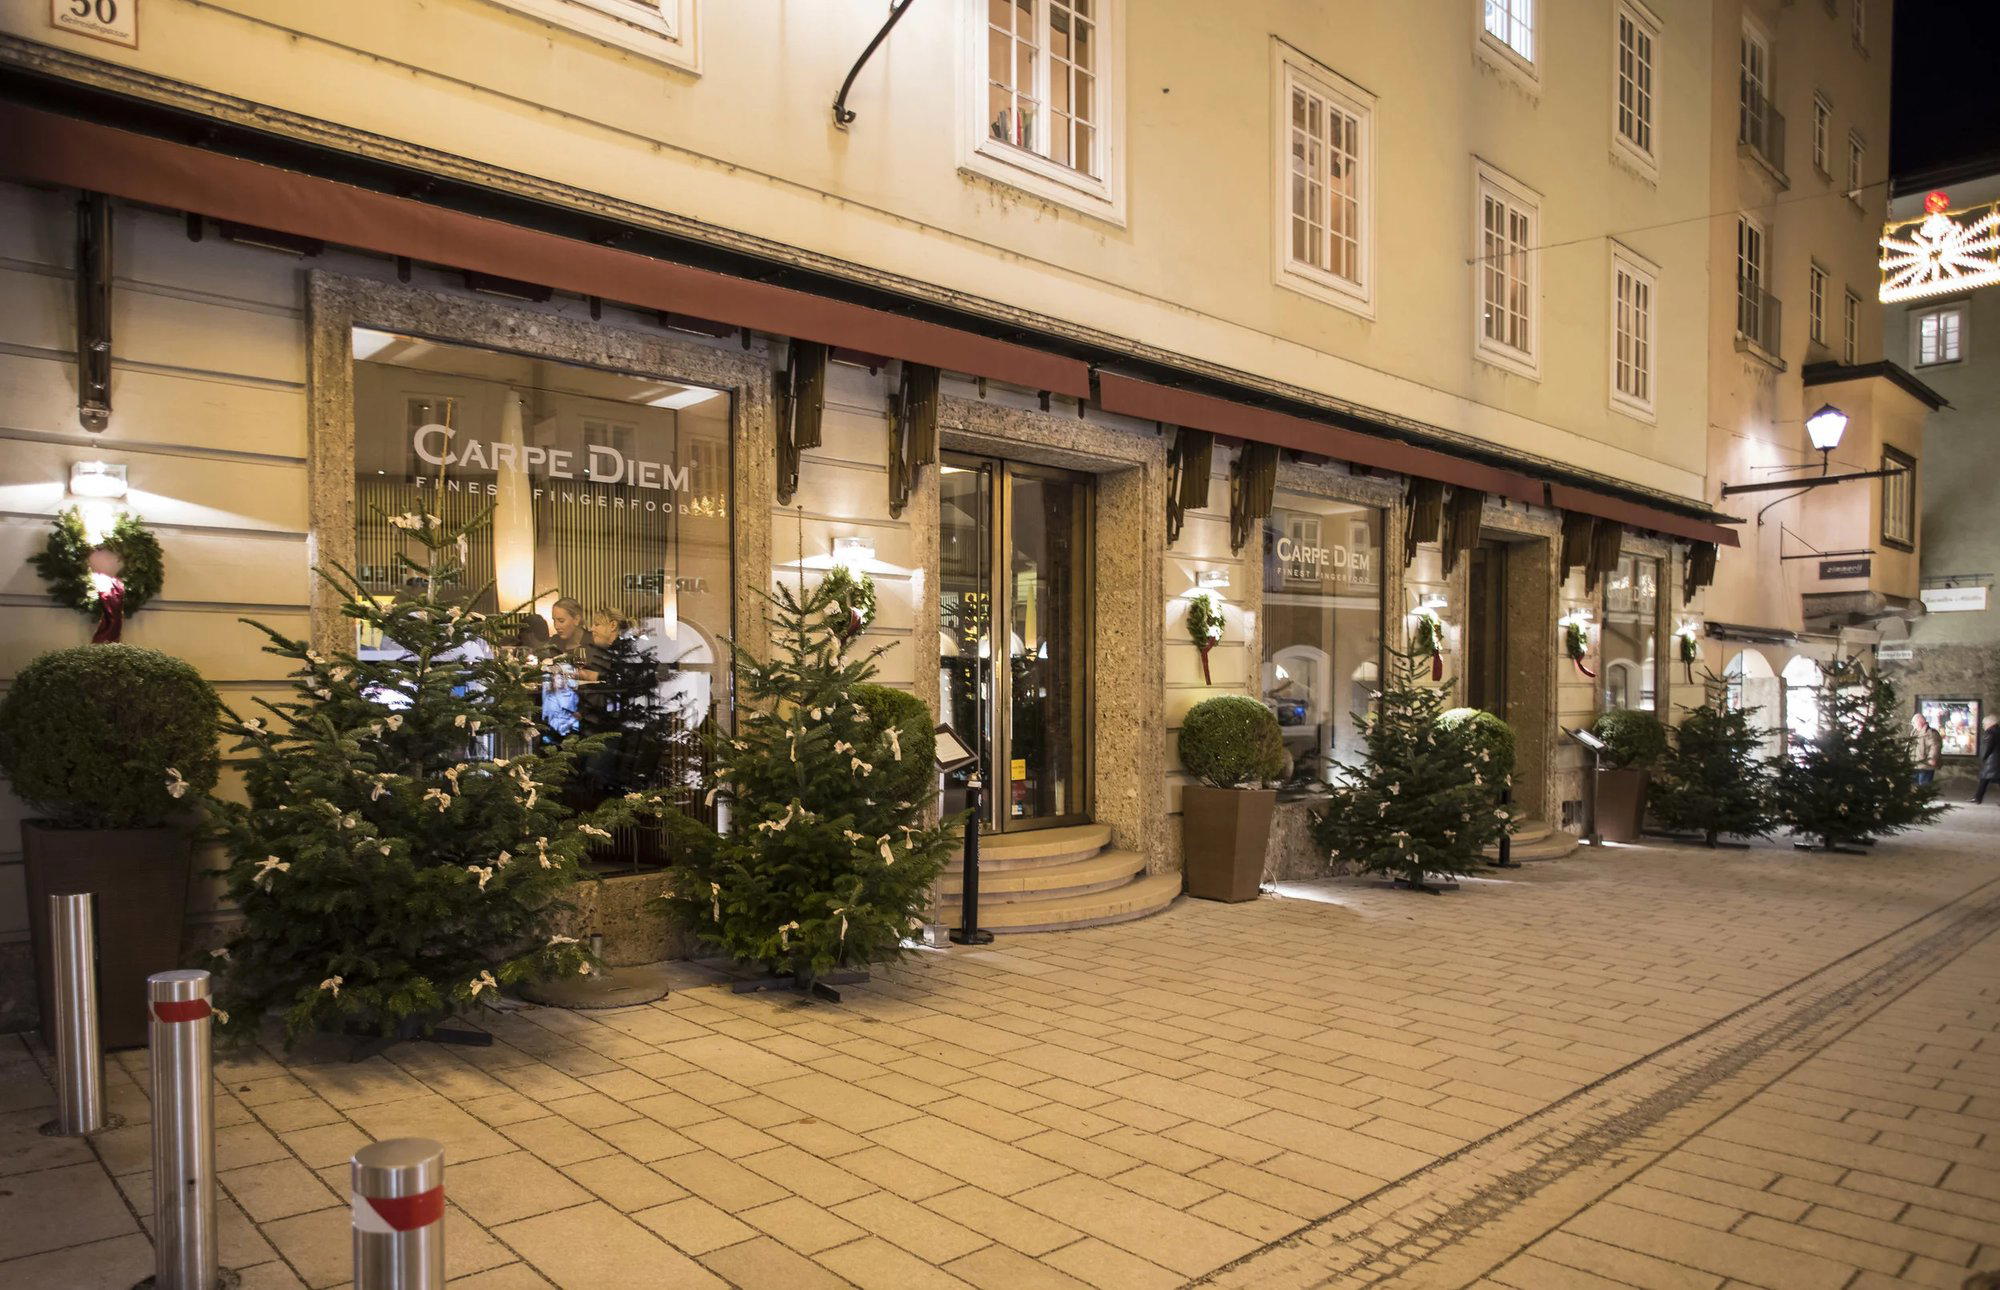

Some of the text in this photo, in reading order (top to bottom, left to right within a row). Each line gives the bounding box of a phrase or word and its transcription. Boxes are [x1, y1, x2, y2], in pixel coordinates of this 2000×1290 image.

[533, 488, 690, 516] FINGERFOOD
[1277, 567, 1370, 584] FINEST FINGEROOD
